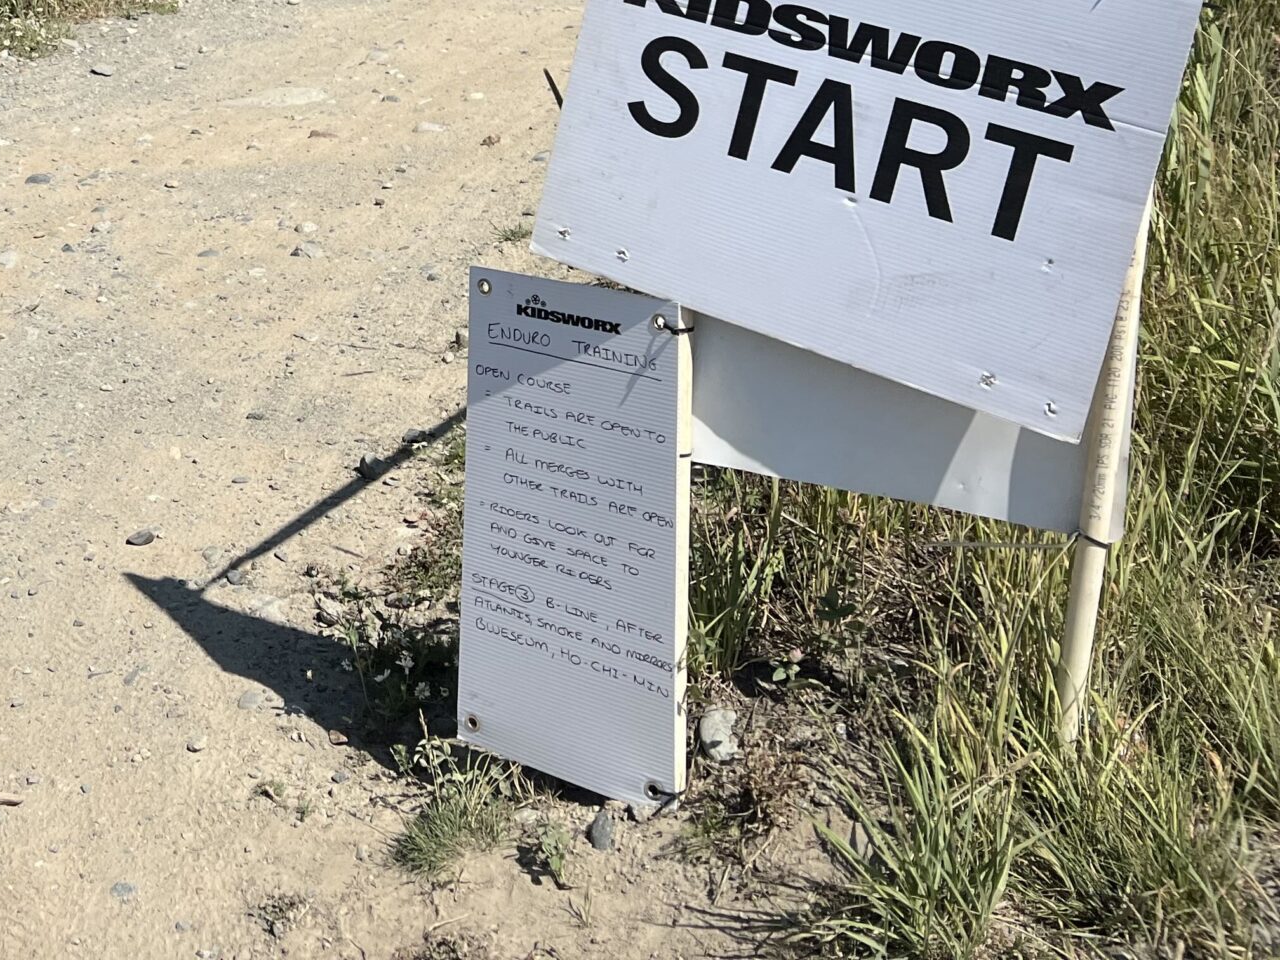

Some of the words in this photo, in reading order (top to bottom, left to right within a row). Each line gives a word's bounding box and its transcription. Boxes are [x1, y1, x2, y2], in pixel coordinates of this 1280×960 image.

[628, 36, 1075, 242] START
[516, 303, 622, 335] KIDSWORX
[488, 322, 551, 347] ENDURO
[572, 340, 657, 371] TRAINING
[476, 364, 510, 381] OPEN
[517, 373, 572, 394] COURSE
[504, 395, 558, 419] TRAILS
[565, 411, 595, 426] ARE
[601, 419, 640, 438] OPEN
[643, 429, 666, 444] TO
[505, 421, 529, 436] THE
[533, 428, 587, 449] PUBLIC
[505, 447, 529, 465] ALL
[535, 459, 590, 481] MERGES
[597, 475, 643, 496] WITH
[503, 472, 543, 492] OTHER
[550, 486, 598, 506] TRAILS
[608, 501, 637, 517] ARE
[642, 511, 674, 529] OPEN
[490, 502, 539, 524] RIDERS
[548, 519, 588, 538] LOOK
[594, 533, 616, 547] OUT
[628, 542, 656, 559] FOR
[490, 522, 517, 539] AND
[523, 533, 556, 551] GIVE
[566, 547, 608, 567] SPACE
[621, 563, 639, 576] TO
[490, 543, 548, 569] YOUNGER
[536, 618, 583, 641] SMOKE
[591, 637, 621, 654] AND
[616, 619, 665, 644] AFTER
